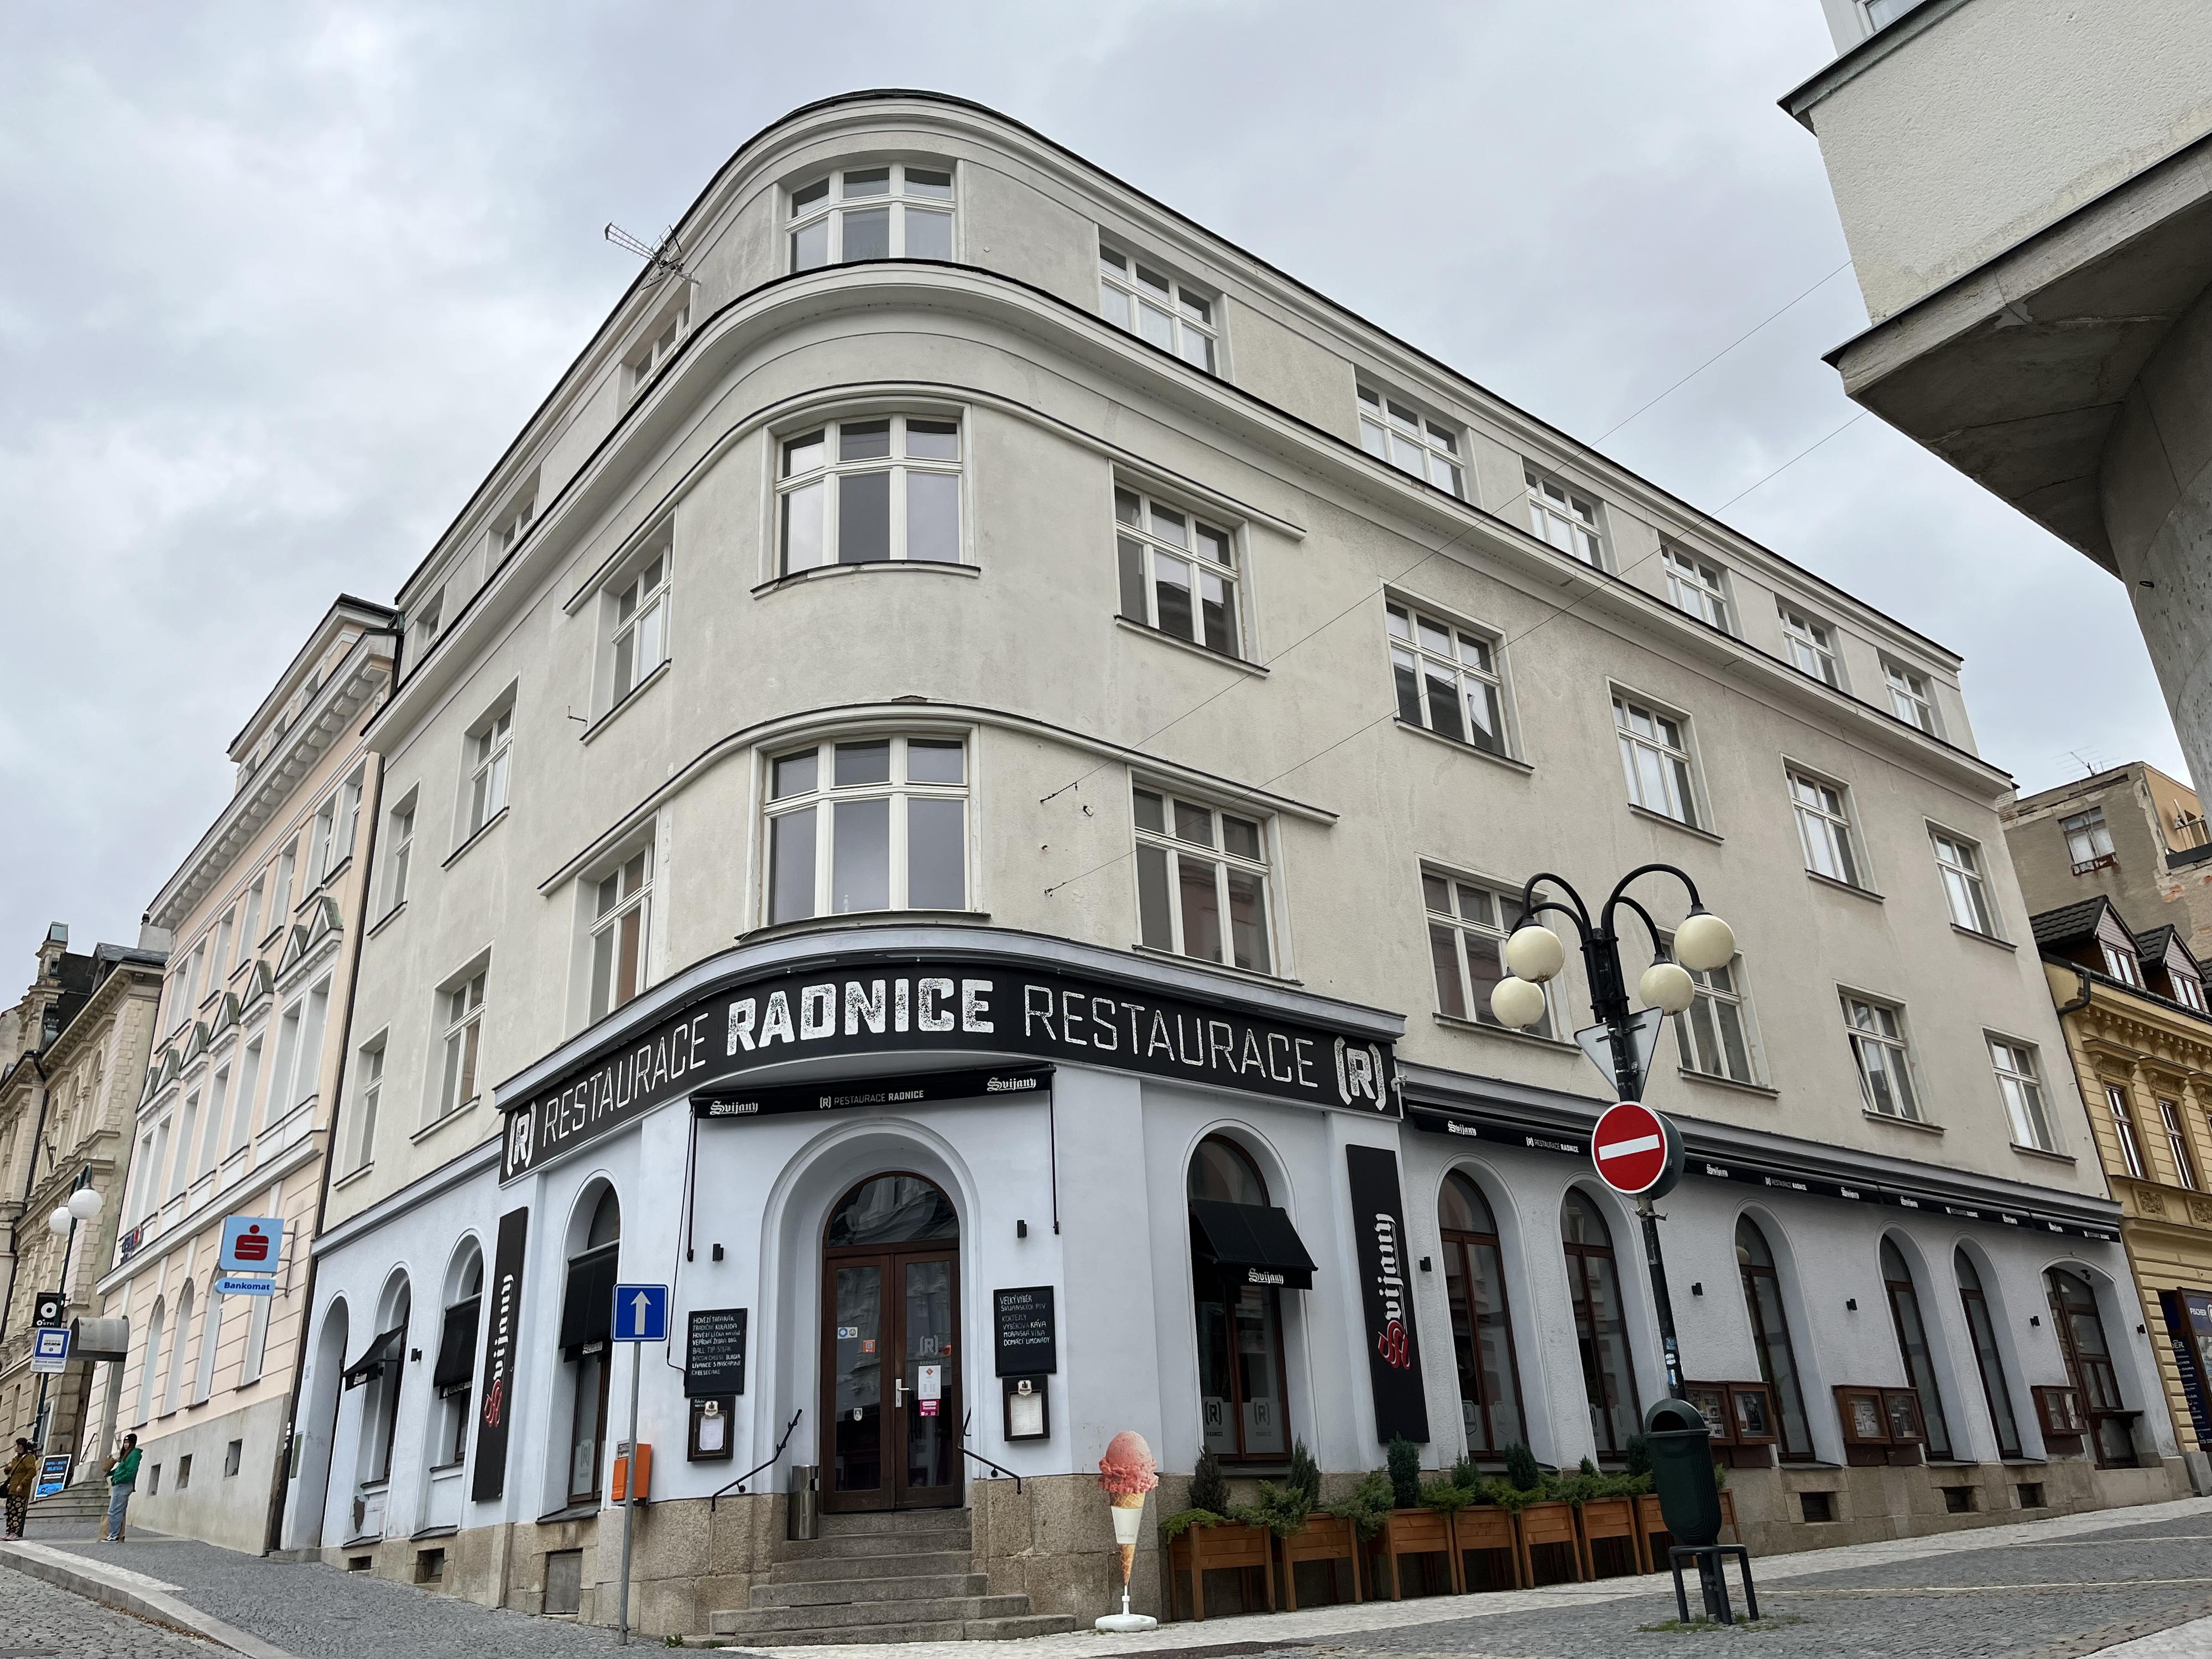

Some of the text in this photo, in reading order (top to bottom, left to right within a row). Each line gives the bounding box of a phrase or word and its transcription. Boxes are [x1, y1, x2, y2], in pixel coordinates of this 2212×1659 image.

[542, 1012, 709, 1147] RESTAURACE
[726, 978, 994, 1056] RADNICE
[1024, 984, 1318, 1088] RESTAURACE
[709, 1100, 759, 1115] Svijany
[834, 1093, 886, 1105] RESTAURACE
[888, 1090, 924, 1102] RADNICE
[987, 1077, 1036, 1092] Svijany
[1448, 1120, 1477, 1136] Svijany
[1535, 1139, 1560, 1150] RESTAURACE
[224, 1282, 270, 1290] Bankomat
[1248, 1267, 1284, 1285] Svijany
[1374, 1213, 1410, 1370] Svijany
[1030, 1319, 1046, 1328] KÁVA
[484, 1274, 514, 1427] Svijany
